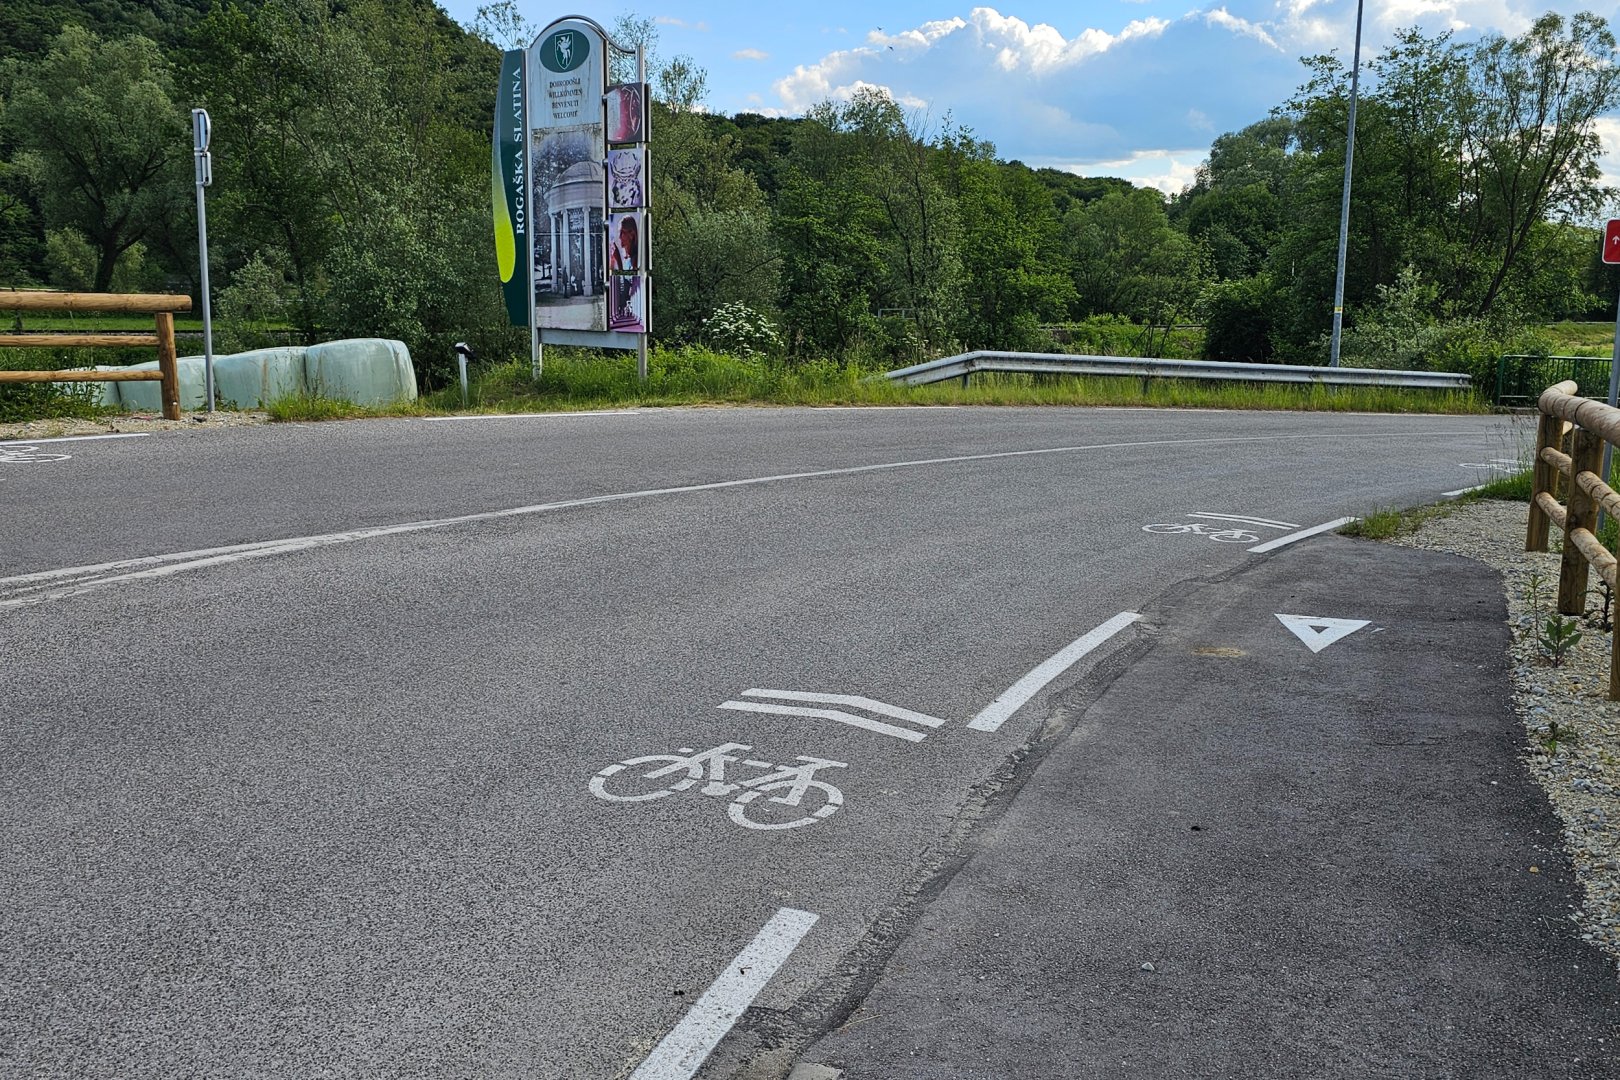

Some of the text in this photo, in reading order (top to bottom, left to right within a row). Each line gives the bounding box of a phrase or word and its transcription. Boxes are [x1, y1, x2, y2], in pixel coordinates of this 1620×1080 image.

[549, 77, 581, 88] DOBRODOŠLI
[548, 88, 583, 99] WILLKOMMEN
[551, 100, 579, 109] BENVENUTI
[552, 110, 578, 119] WELCOME
[512, 67, 525, 234] ROGAŠKA SLATINA
